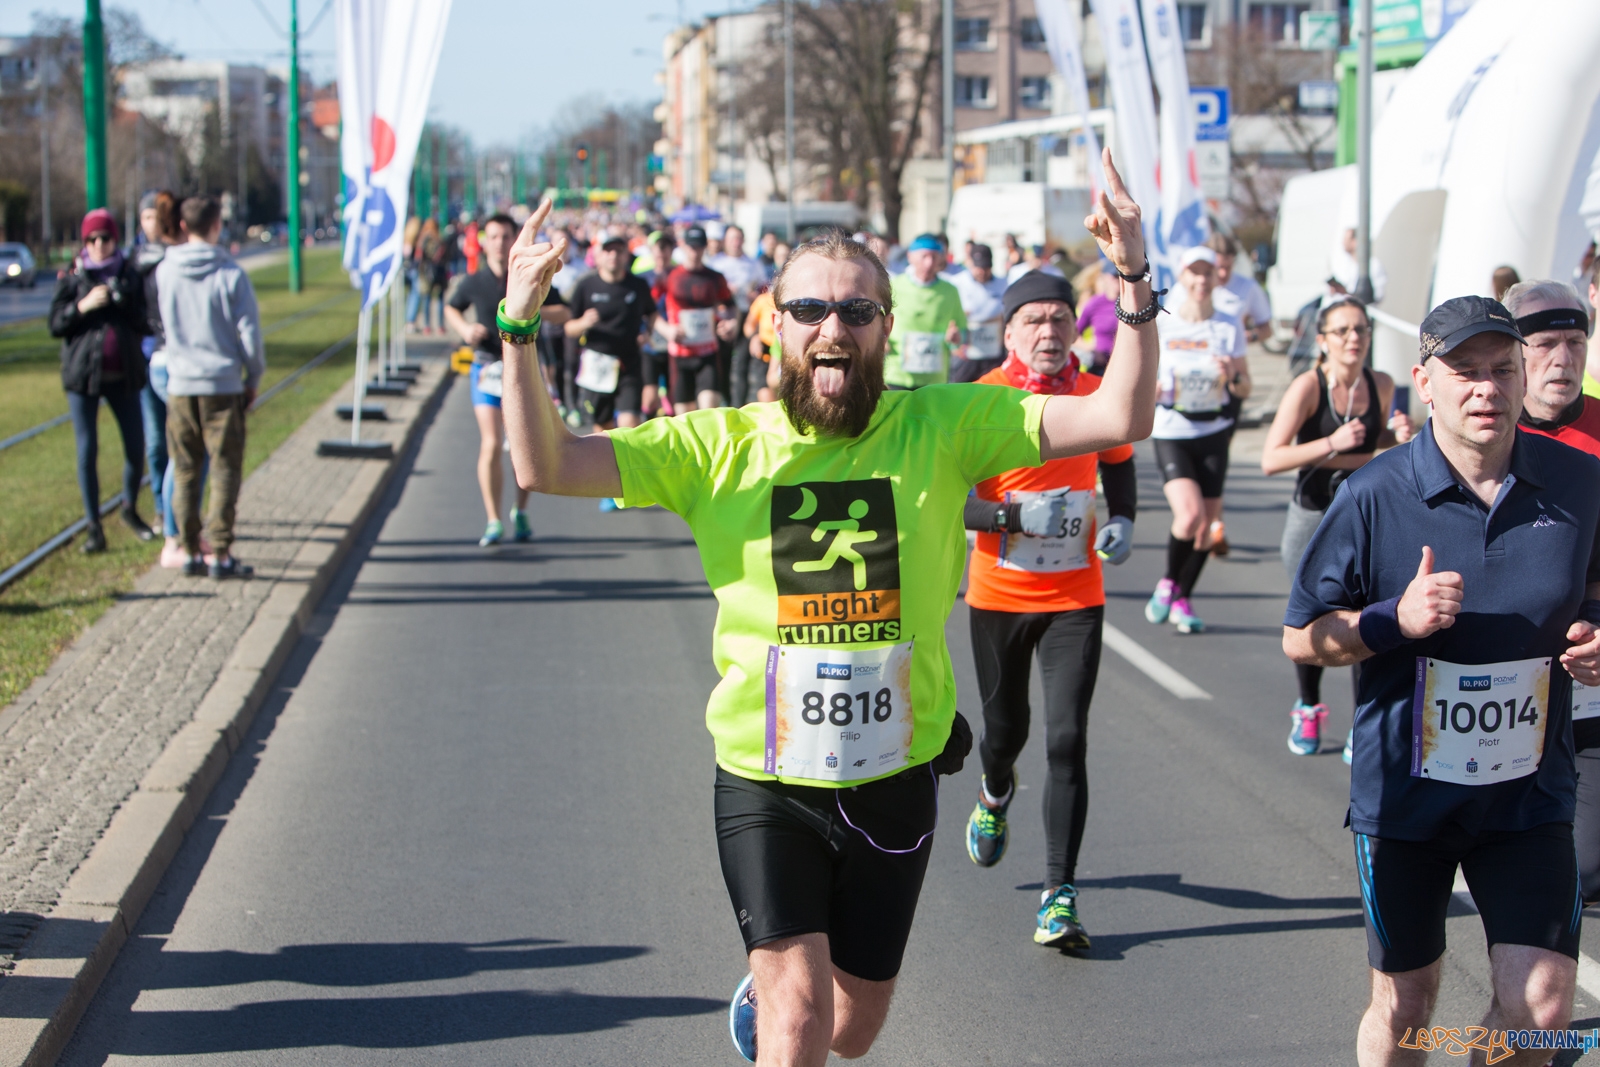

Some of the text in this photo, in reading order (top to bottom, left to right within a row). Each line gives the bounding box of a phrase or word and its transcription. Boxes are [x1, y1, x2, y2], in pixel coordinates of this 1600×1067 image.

[1191, 92, 1220, 126] P
[803, 593, 879, 620] night
[779, 620, 899, 644] runners
[820, 667, 849, 676] 10. PKO
[801, 687, 893, 726] 8818
[1435, 695, 1539, 734] 10014
[840, 730, 861, 742] Filip
[1478, 737, 1500, 748] Piotr
